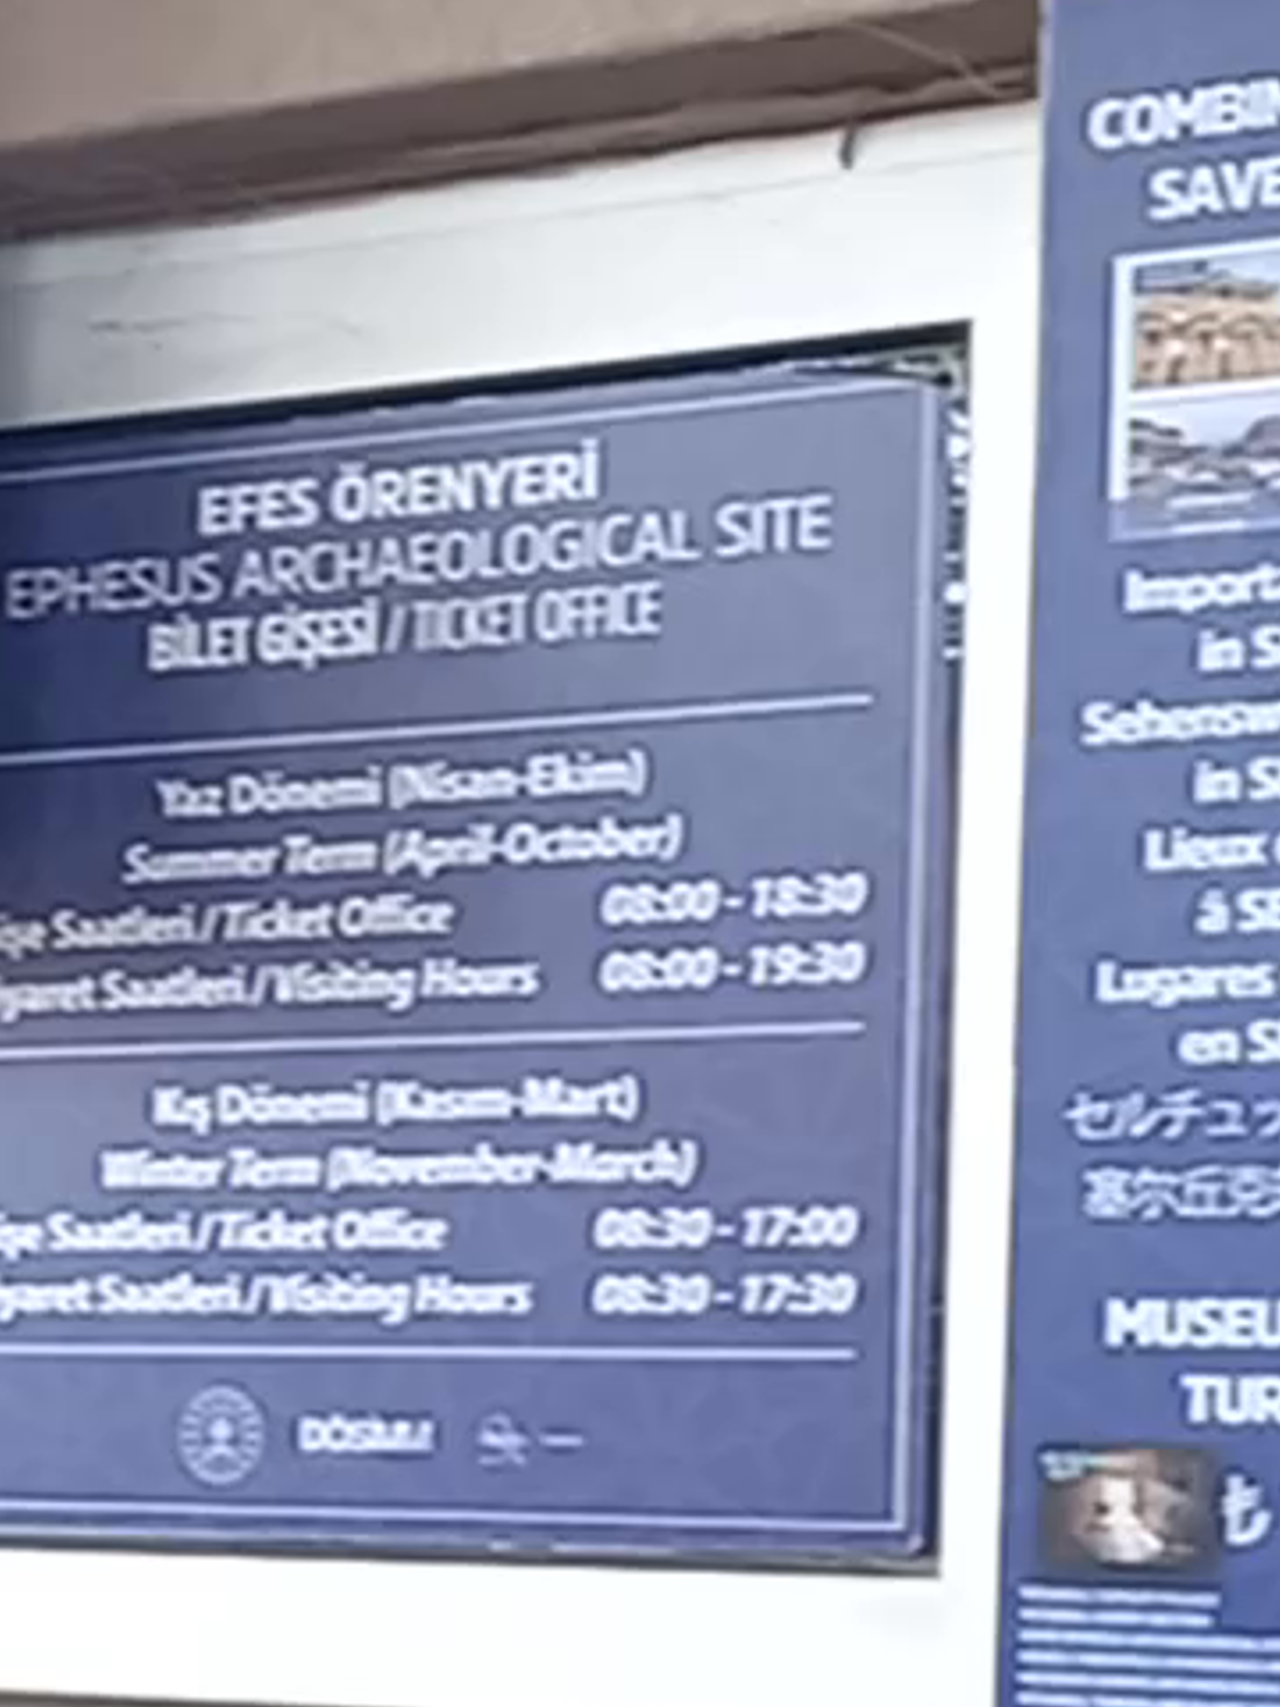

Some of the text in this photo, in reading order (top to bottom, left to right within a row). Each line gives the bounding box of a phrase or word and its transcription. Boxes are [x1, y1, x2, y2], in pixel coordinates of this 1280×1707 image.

[197, 438, 599, 537] EFES ÖRENYERİ
[6, 495, 834, 619] EPHESUS ARCHAEOLOGICAL SITE
[147, 613, 252, 672] BİLET
[412, 593, 529, 651] TICKET
[534, 580, 663, 643] OFFICE
[1198, 630, 1245, 671] in
[157, 780, 222, 817] Yaz
[229, 764, 382, 814] Dönemi
[1193, 760, 1240, 802] in
[123, 840, 279, 883] Summer
[282, 835, 377, 874] Term
[1144, 826, 1269, 871] Lieux
[339, 892, 454, 937] Office
[1096, 961, 1276, 1008] Lugares
[1178, 1030, 1241, 1065] en
[228, 1147, 320, 1188] Term
